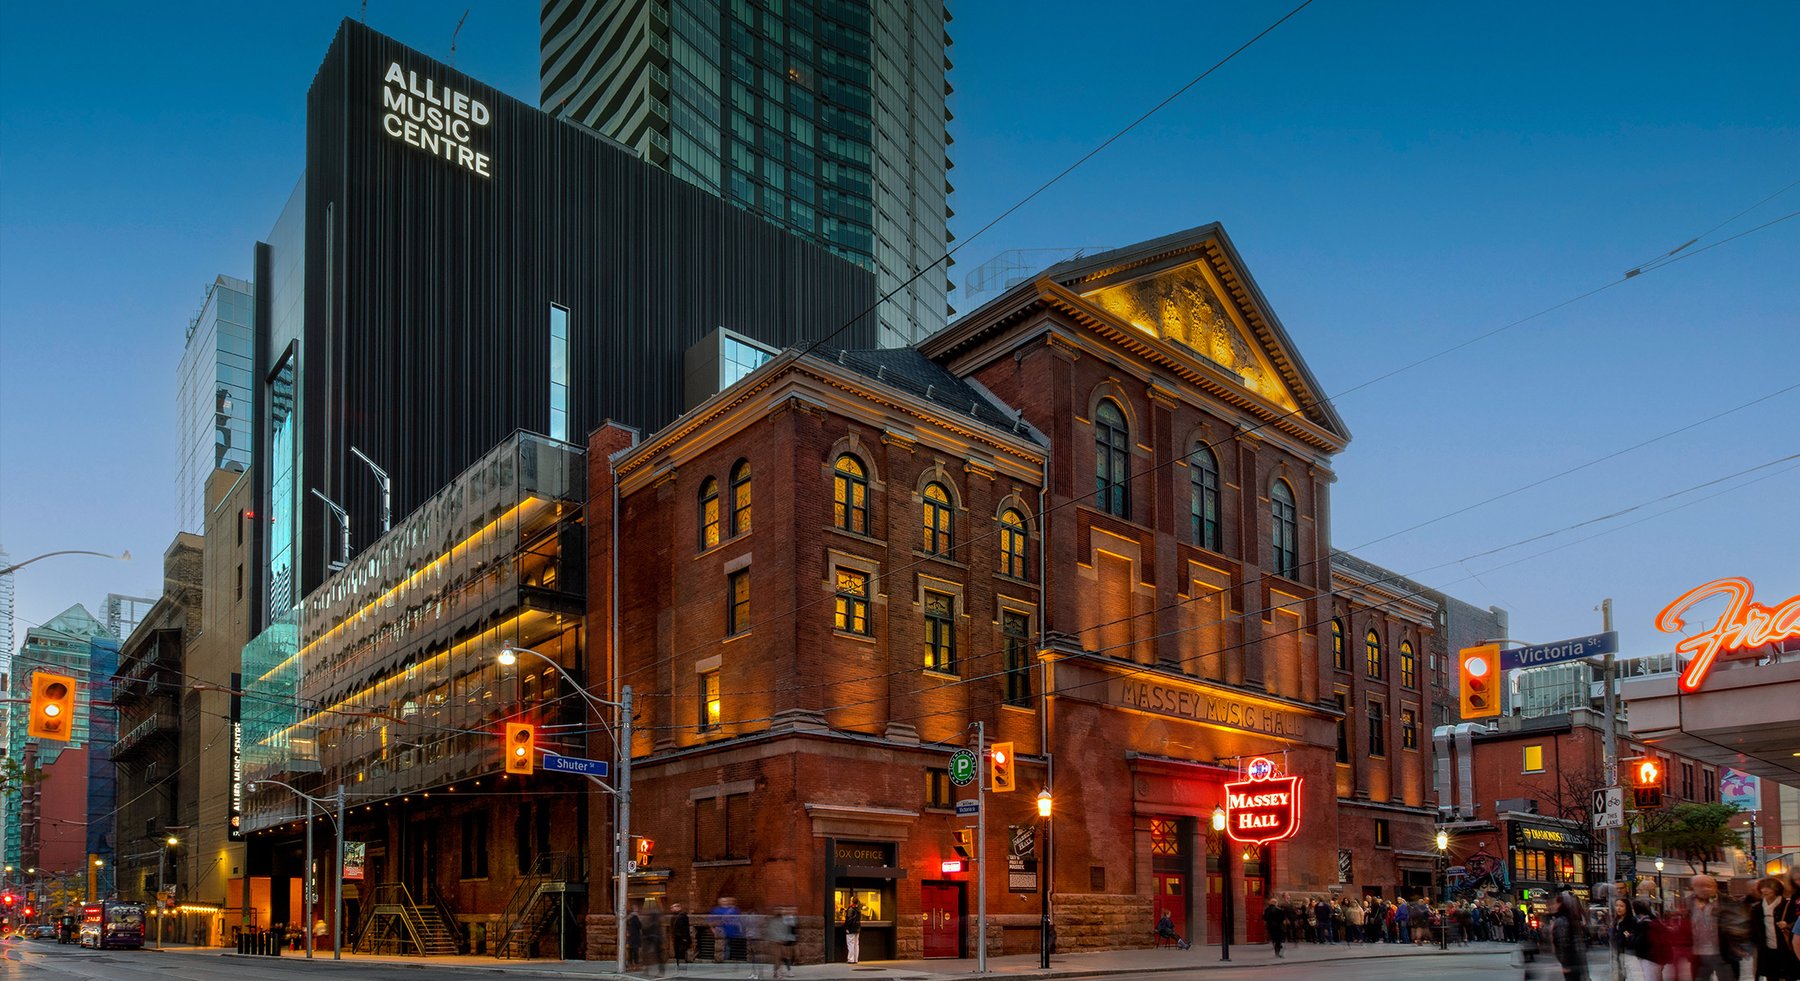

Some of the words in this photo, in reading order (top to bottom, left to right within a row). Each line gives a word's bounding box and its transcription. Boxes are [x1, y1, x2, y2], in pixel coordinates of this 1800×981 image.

[384, 62, 490, 126] ALLIED
[383, 85, 470, 143] MUSIC
[383, 113, 490, 178] CENTRE
[1518, 641, 1584, 664] Victoria
[1122, 678, 1200, 718] MASSEY
[1205, 696, 1255, 728] MUSIC
[1262, 709, 1305, 736] HALL
[557, 758, 588, 771] Shuter
[1229, 793, 1290, 809] MASSEY
[1238, 813, 1279, 829] HALL
[1531, 829, 1561, 842] DIAMONDS
[854, 850, 883, 859] OFFICE
